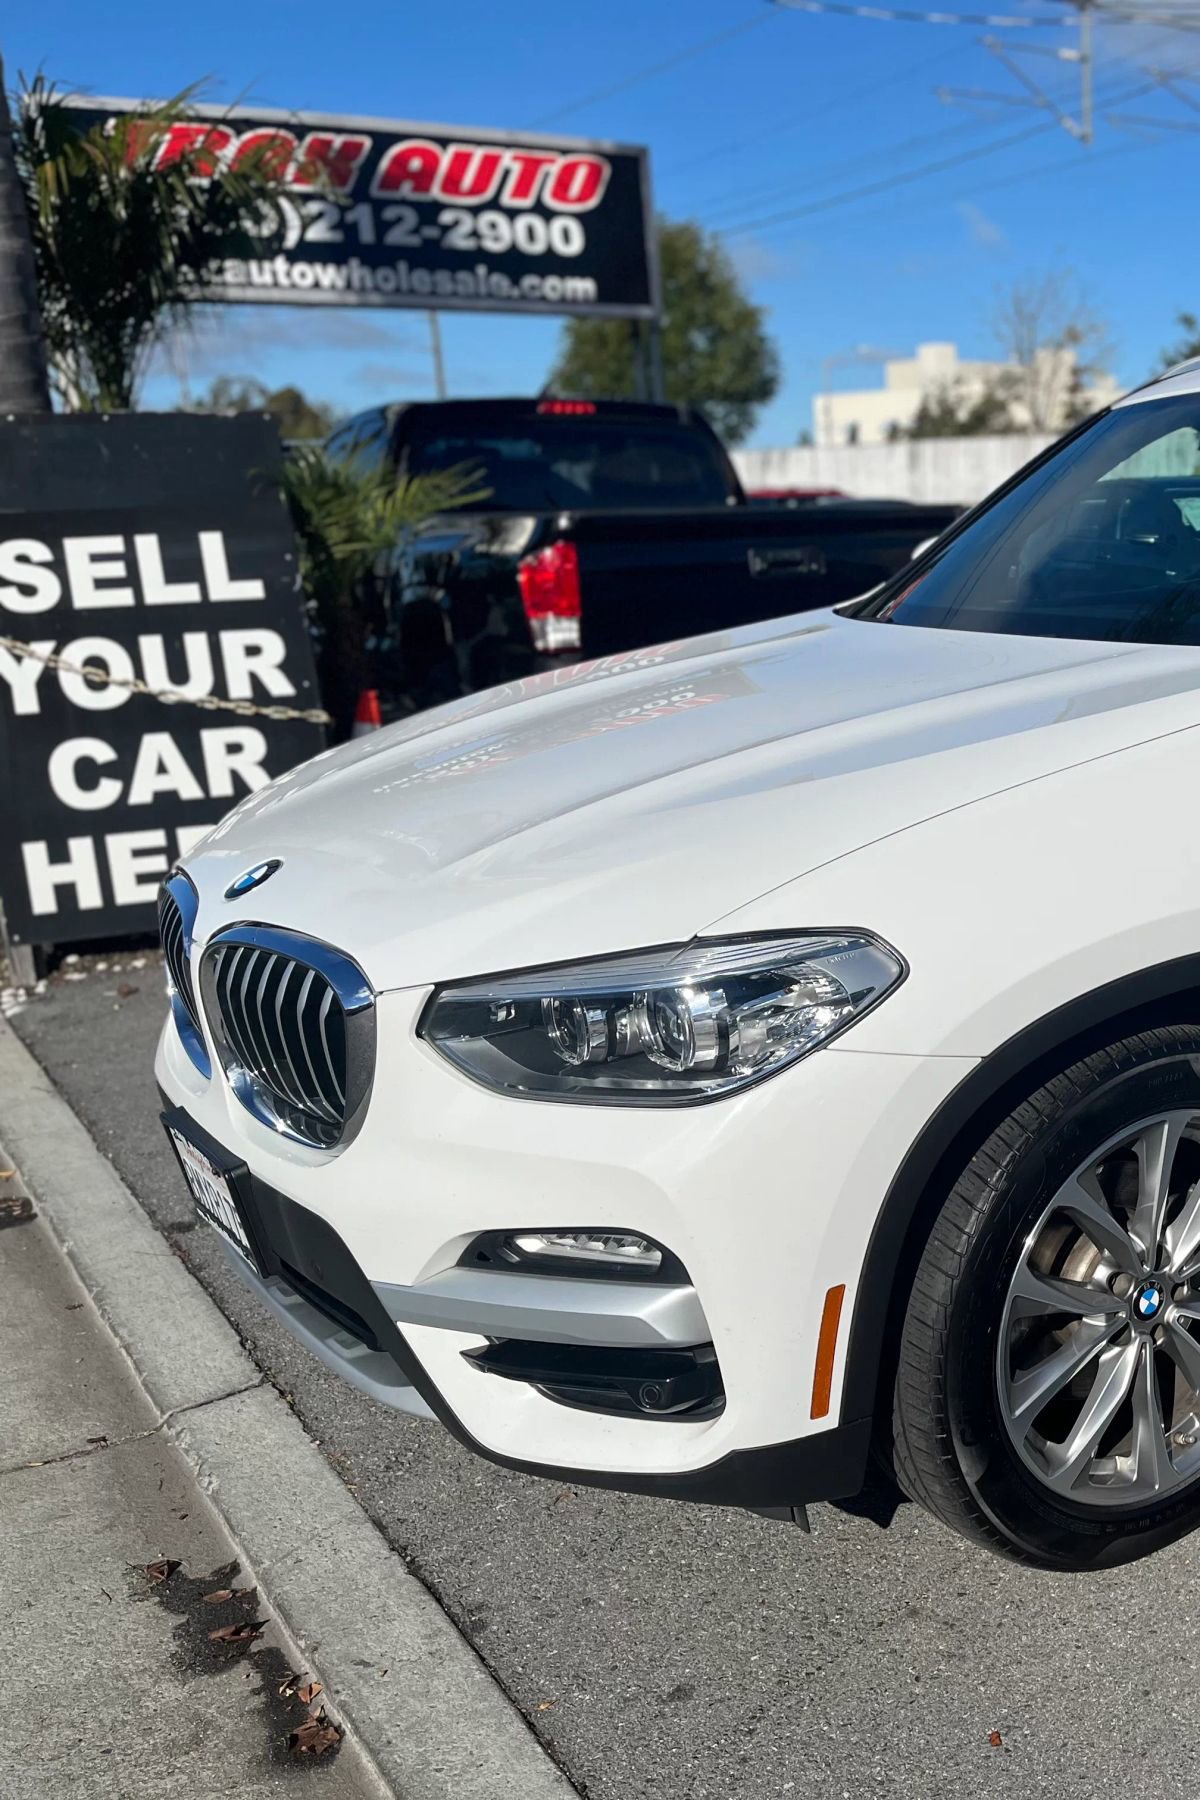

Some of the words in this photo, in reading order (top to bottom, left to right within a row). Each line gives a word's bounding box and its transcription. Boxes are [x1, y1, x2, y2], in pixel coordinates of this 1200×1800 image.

[369, 138, 612, 215] AUTO
[0, 531, 265, 614] SELL
[0, 628, 297, 716] YOUR
[48, 726, 272, 811] CAR
